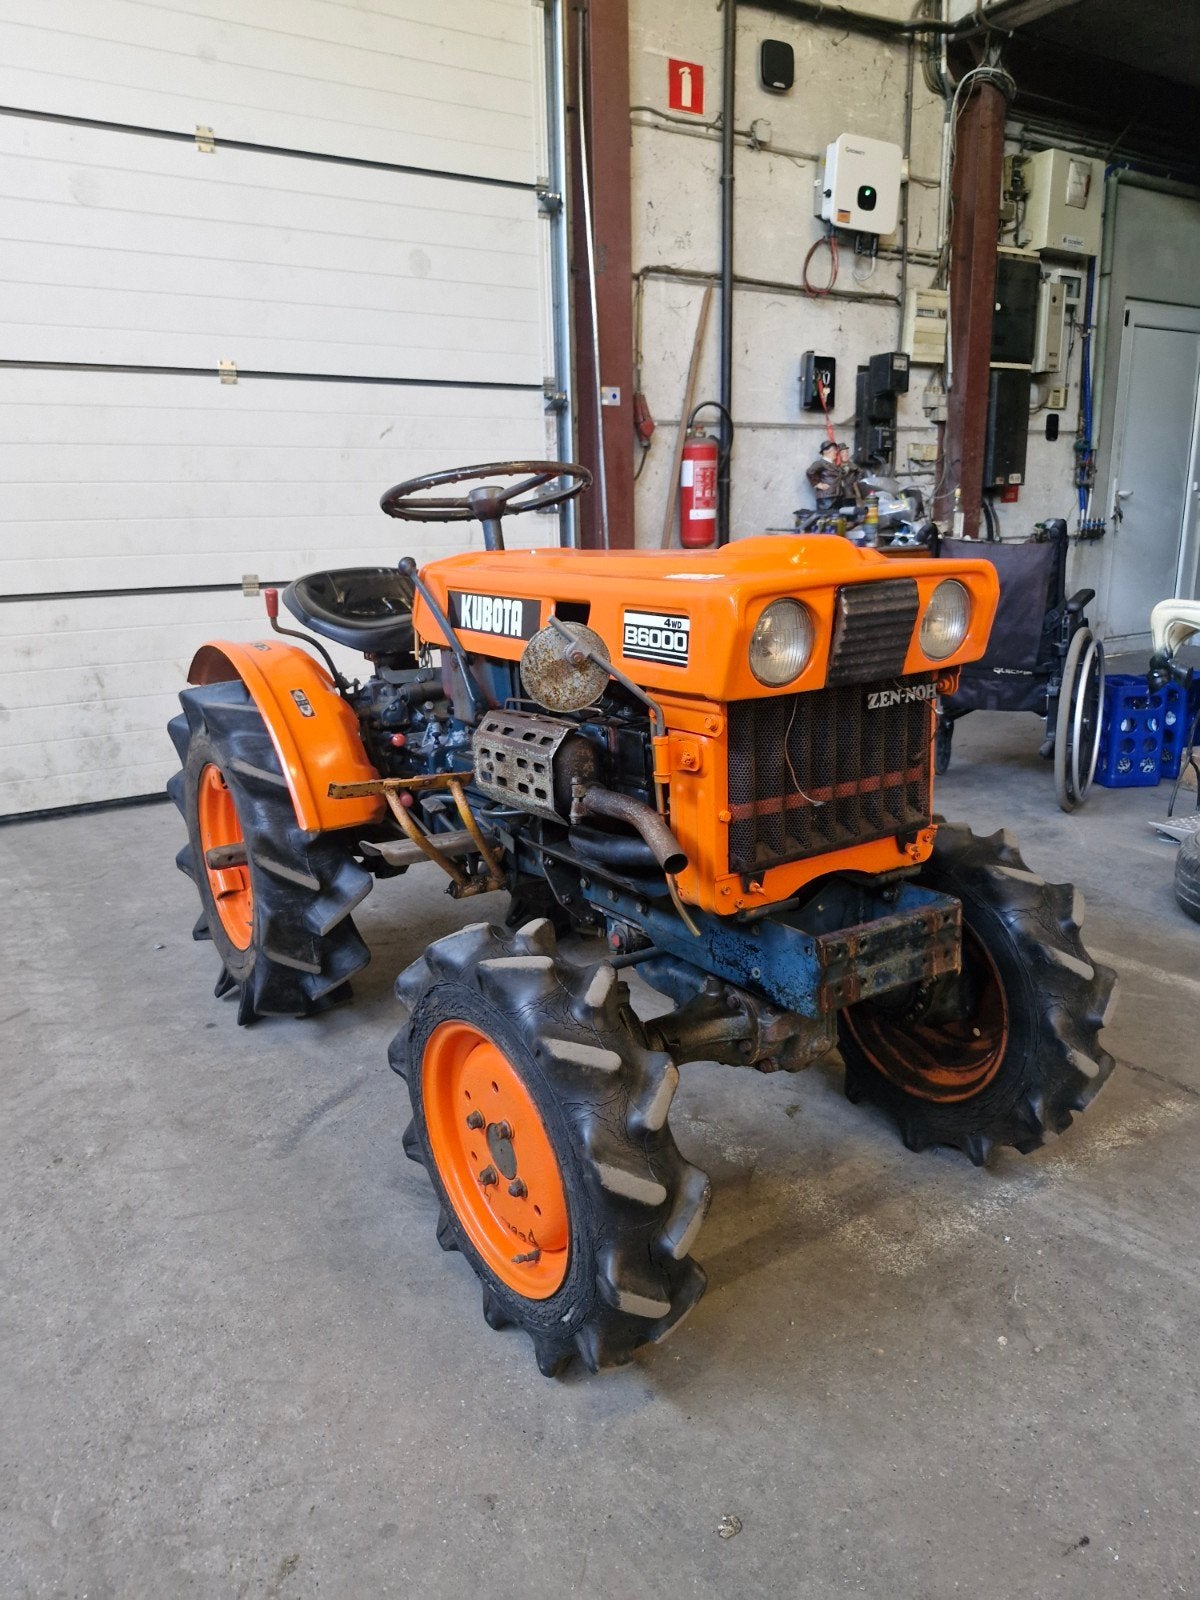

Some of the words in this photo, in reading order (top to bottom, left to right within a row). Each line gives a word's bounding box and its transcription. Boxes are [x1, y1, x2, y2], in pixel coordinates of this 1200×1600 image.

[461, 594, 523, 637] KUBOTA
[664, 618, 682, 629] 4WD
[624, 625, 688, 652] B6000
[867, 683, 938, 710] ZEN-NOH
